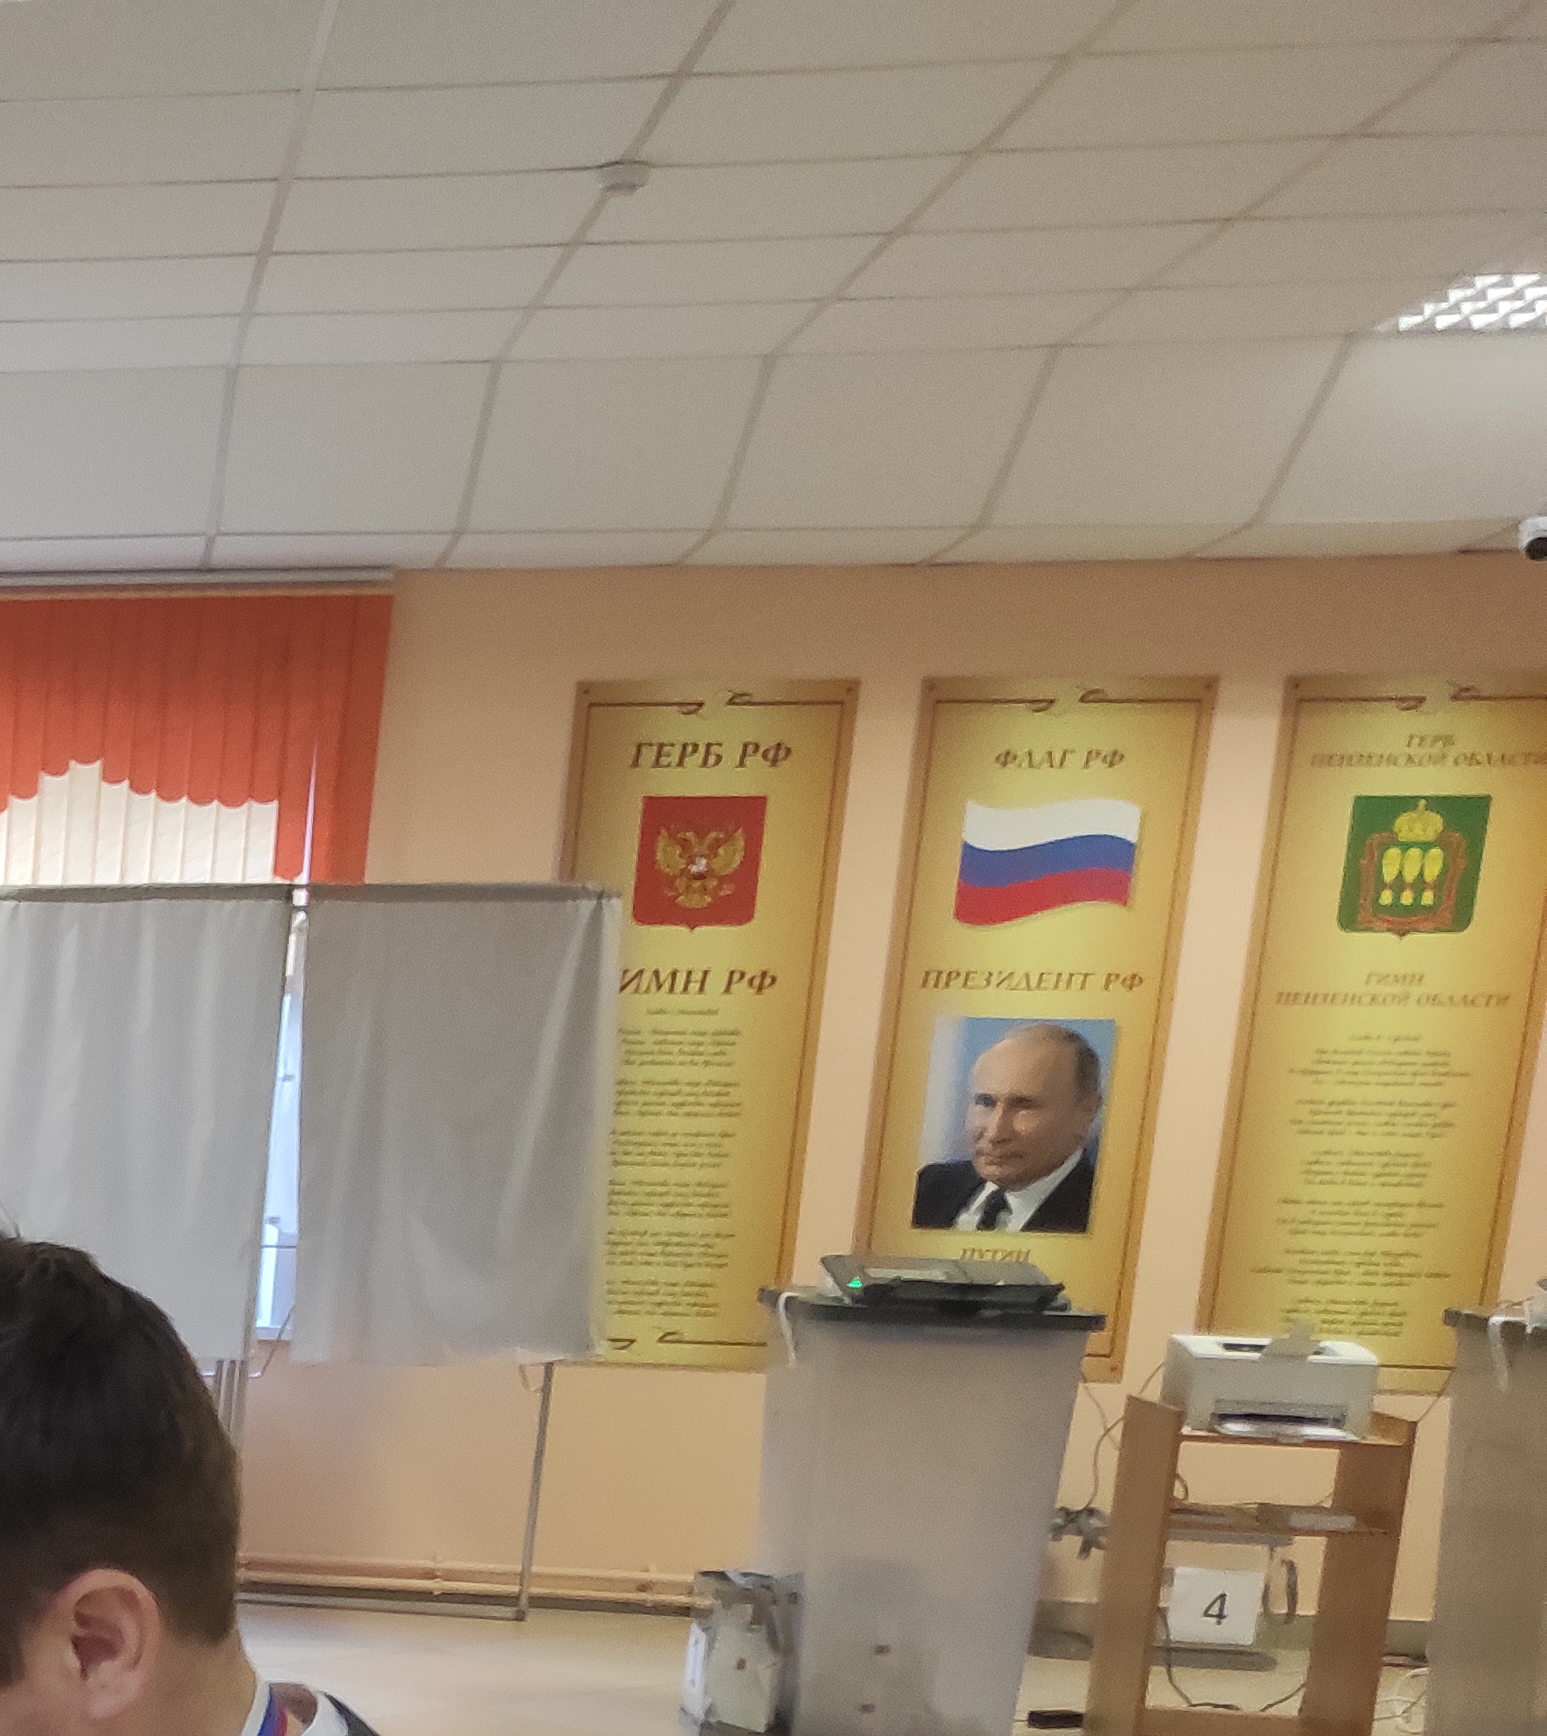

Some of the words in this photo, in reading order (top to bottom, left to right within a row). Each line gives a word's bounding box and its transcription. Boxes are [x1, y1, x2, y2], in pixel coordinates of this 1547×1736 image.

[629, 741, 724, 769] ГЕРБ
[734, 740, 793, 769] РФ
[994, 749, 1075, 770] ФЛАГ
[1081, 748, 1126, 770] РФ
[618, 967, 712, 995] ИМН
[721, 968, 779, 996] РФ
[921, 969, 1094, 992] ПРЕЗИДЕНТ
[1102, 972, 1145, 993] РФ
[1203, 1592, 1227, 1625] 4
